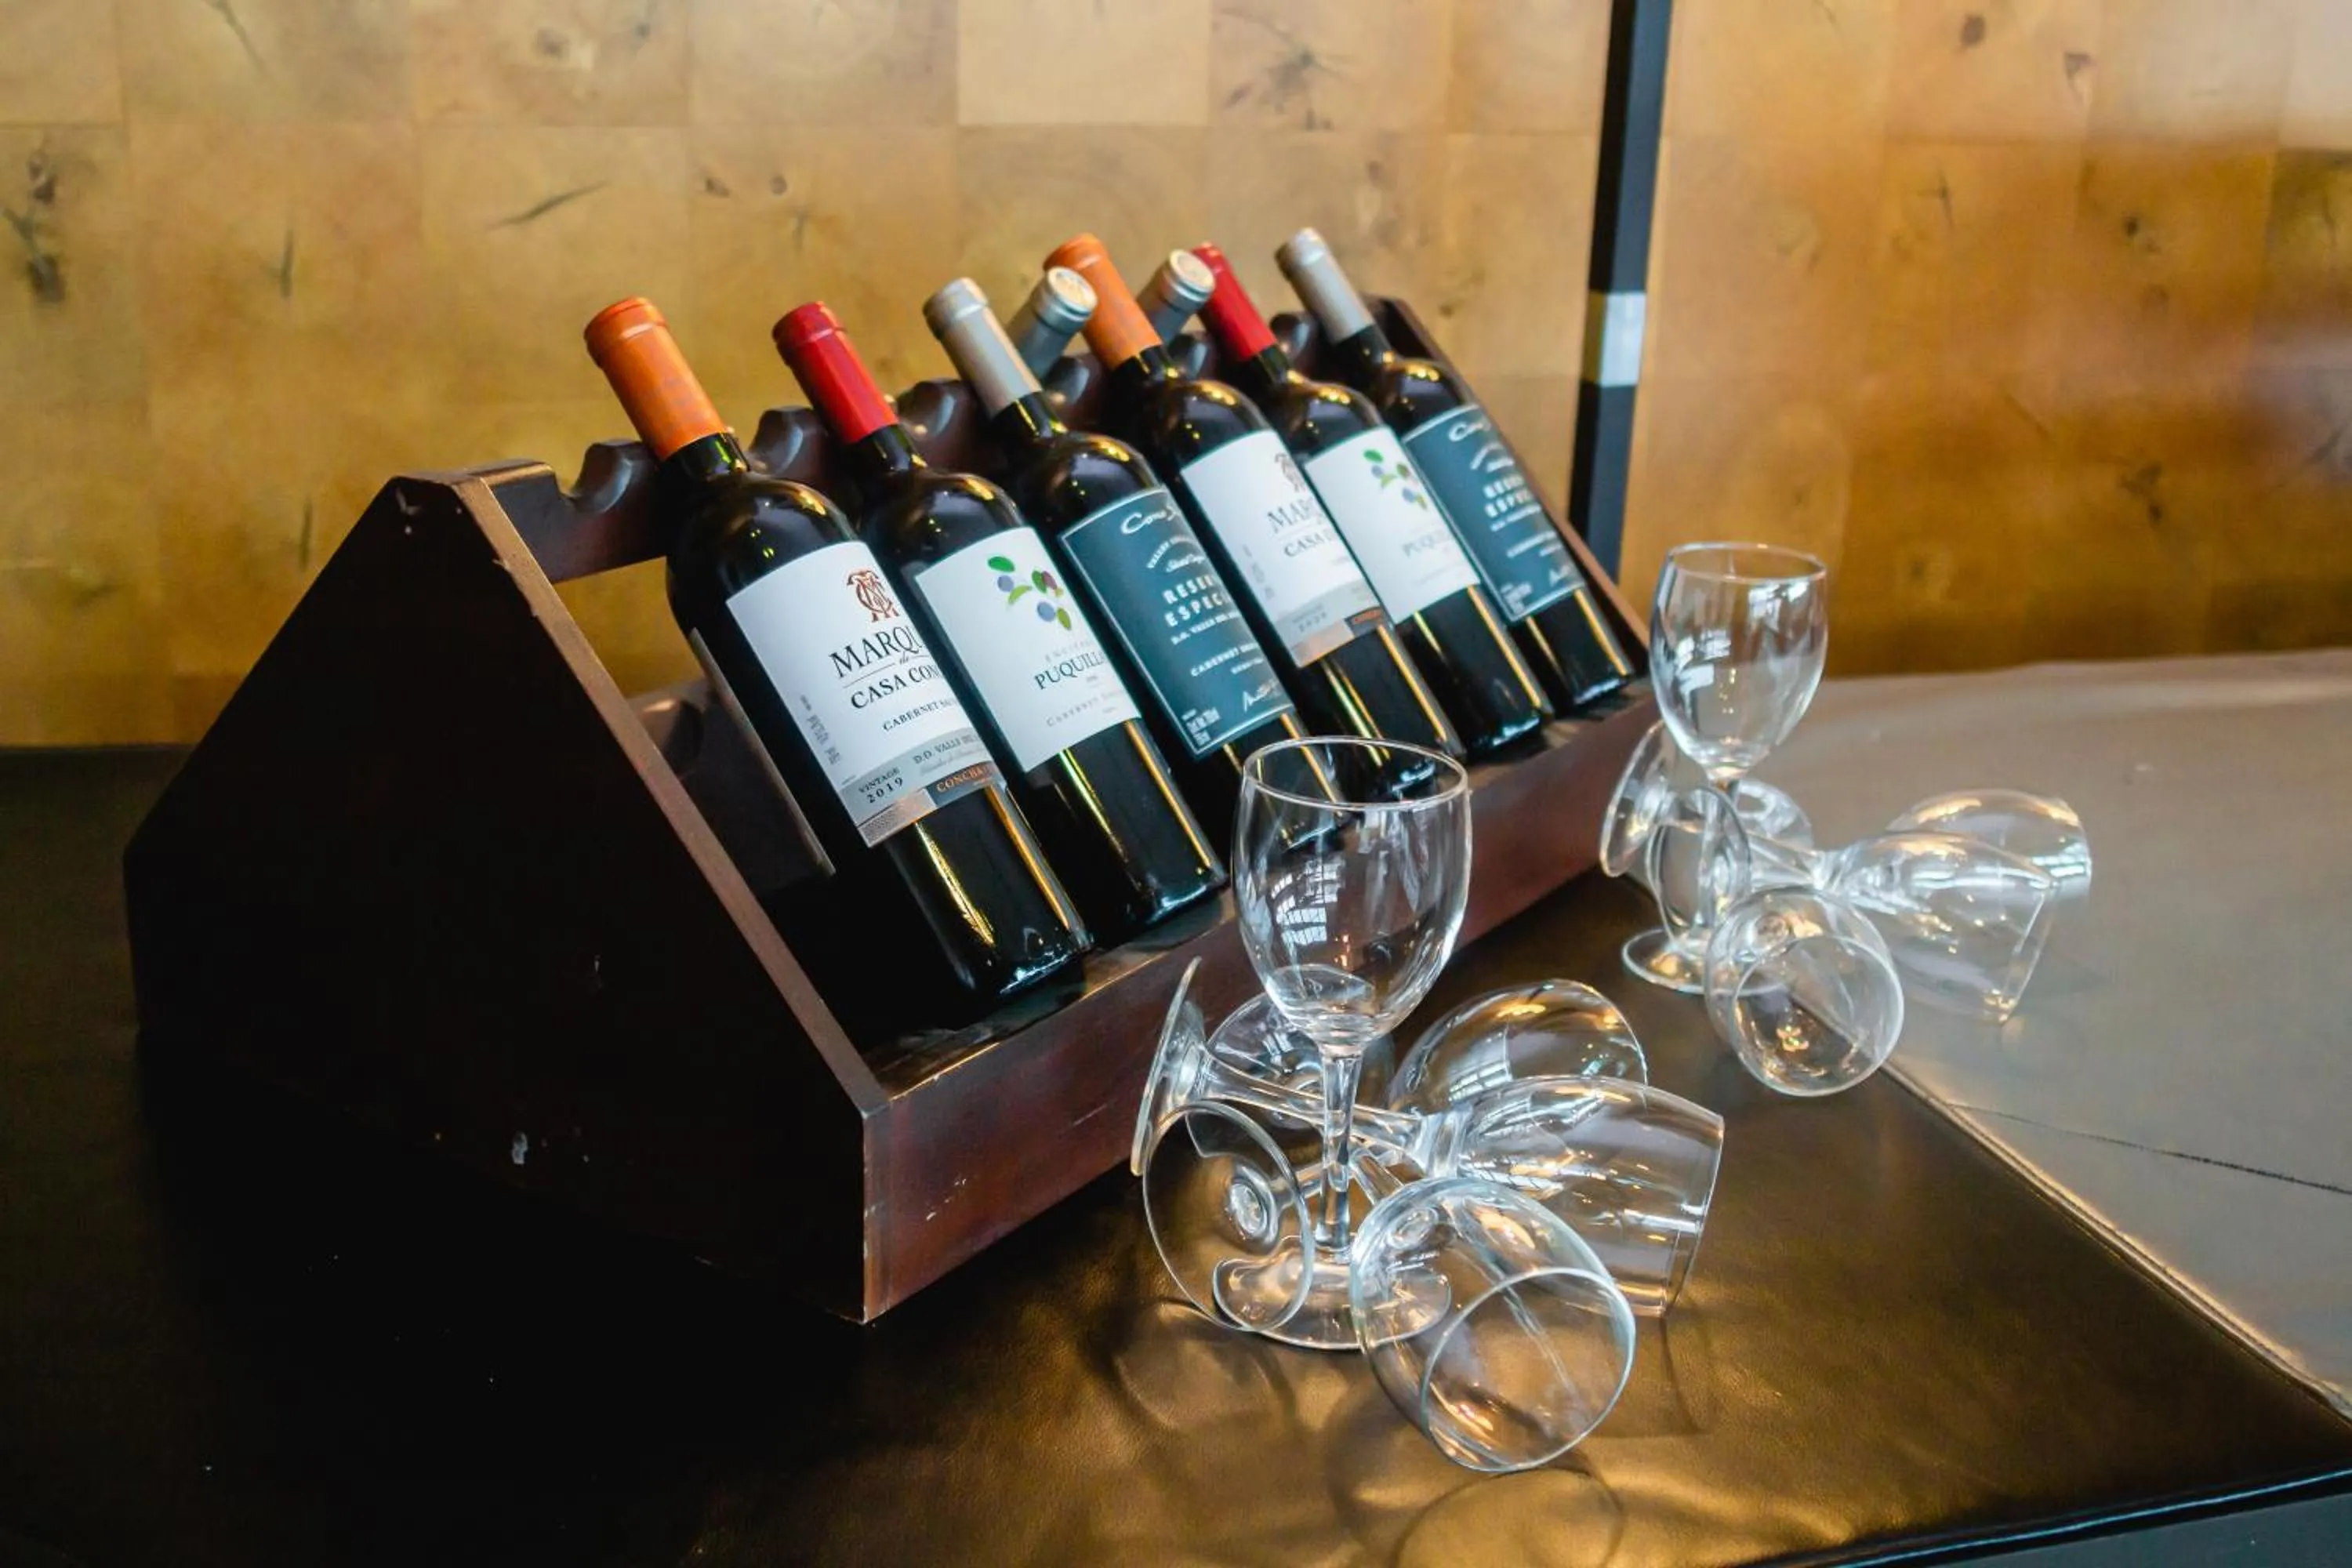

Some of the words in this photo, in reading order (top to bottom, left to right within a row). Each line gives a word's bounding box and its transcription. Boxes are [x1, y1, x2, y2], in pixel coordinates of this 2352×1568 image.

[851, 673, 907, 710] CASA
[882, 700, 939, 731] CABERNET
[866, 776, 903, 804] 2019
